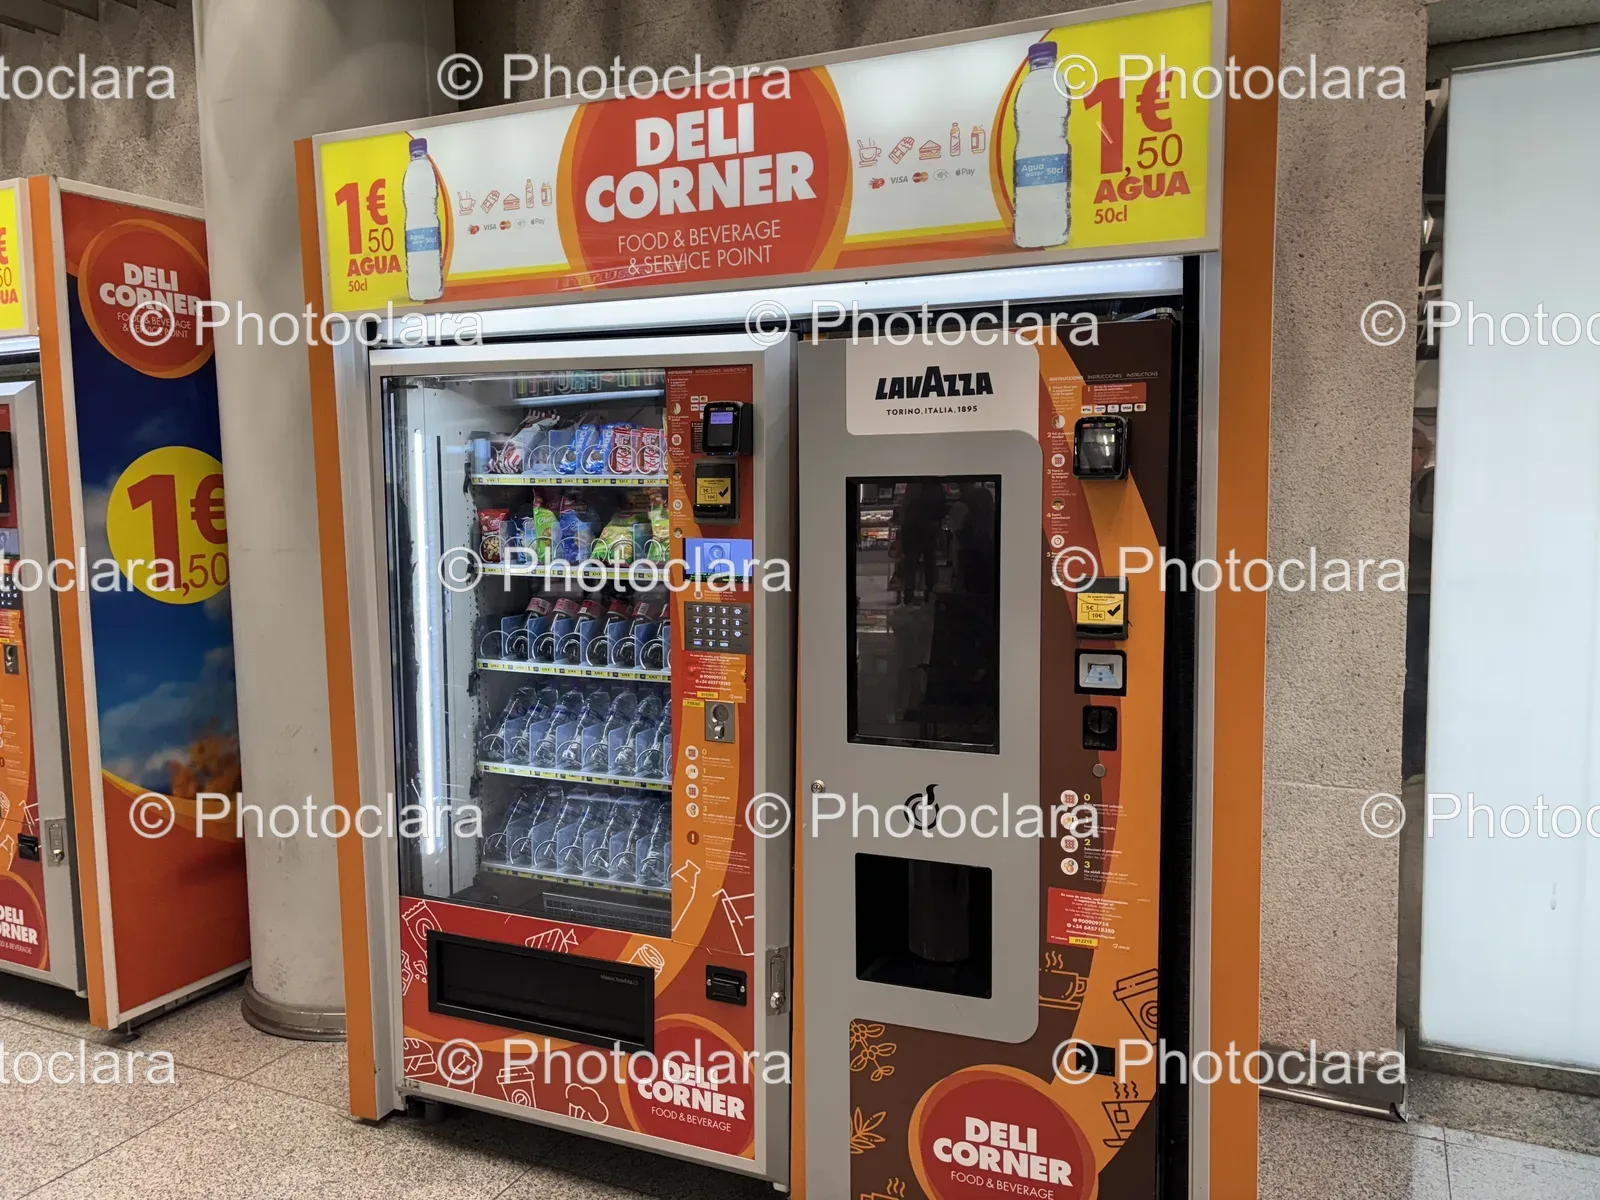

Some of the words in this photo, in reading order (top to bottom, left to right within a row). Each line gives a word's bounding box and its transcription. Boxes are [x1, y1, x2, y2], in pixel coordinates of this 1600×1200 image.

[635, 102, 755, 167] DELI
[890, 175, 909, 184] VISA
[1021, 163, 1045, 173] Agua
[1047, 166, 1064, 175] 50cl
[585, 150, 817, 223] CORNER
[1093, 171, 1191, 204] AGUA
[483, 223, 497, 231] VISA
[1093, 206, 1128, 225] 50cl
[618, 231, 669, 253] FOOD
[672, 230, 685, 248] &
[689, 219, 781, 246] BEVERAGE
[347, 254, 402, 277] AGUA
[628, 257, 640, 275] &
[644, 250, 711, 273] SERVICE
[717, 245, 773, 267] POINT
[123, 262, 179, 292] DELI
[348, 278, 368, 292] 50cl
[99, 282, 205, 317] CORNER
[151, 316, 192, 330] BEVEAGE
[875, 366, 994, 400] LAVAZZA
[957, 405, 978, 413] 1895
[1083, 793, 1091, 801] 0
[1084, 861, 1091, 869] 3
[0, 921, 39, 946] RNER
[1077, 918, 1109, 927] 900909714
[663, 1058, 719, 1092] DELI
[637, 1077, 746, 1121] CORNER
[651, 1106, 677, 1121] FOOD
[678, 1112, 686, 1123] &
[686, 1113, 732, 1133] BEVERAGE
[965, 1116, 1038, 1154] DELI
[932, 1137, 1074, 1187] CORNER
[950, 1171, 984, 1186] FOOD
[986, 1178, 995, 1190] &
[996, 1179, 1054, 1200] BEVERAGE
